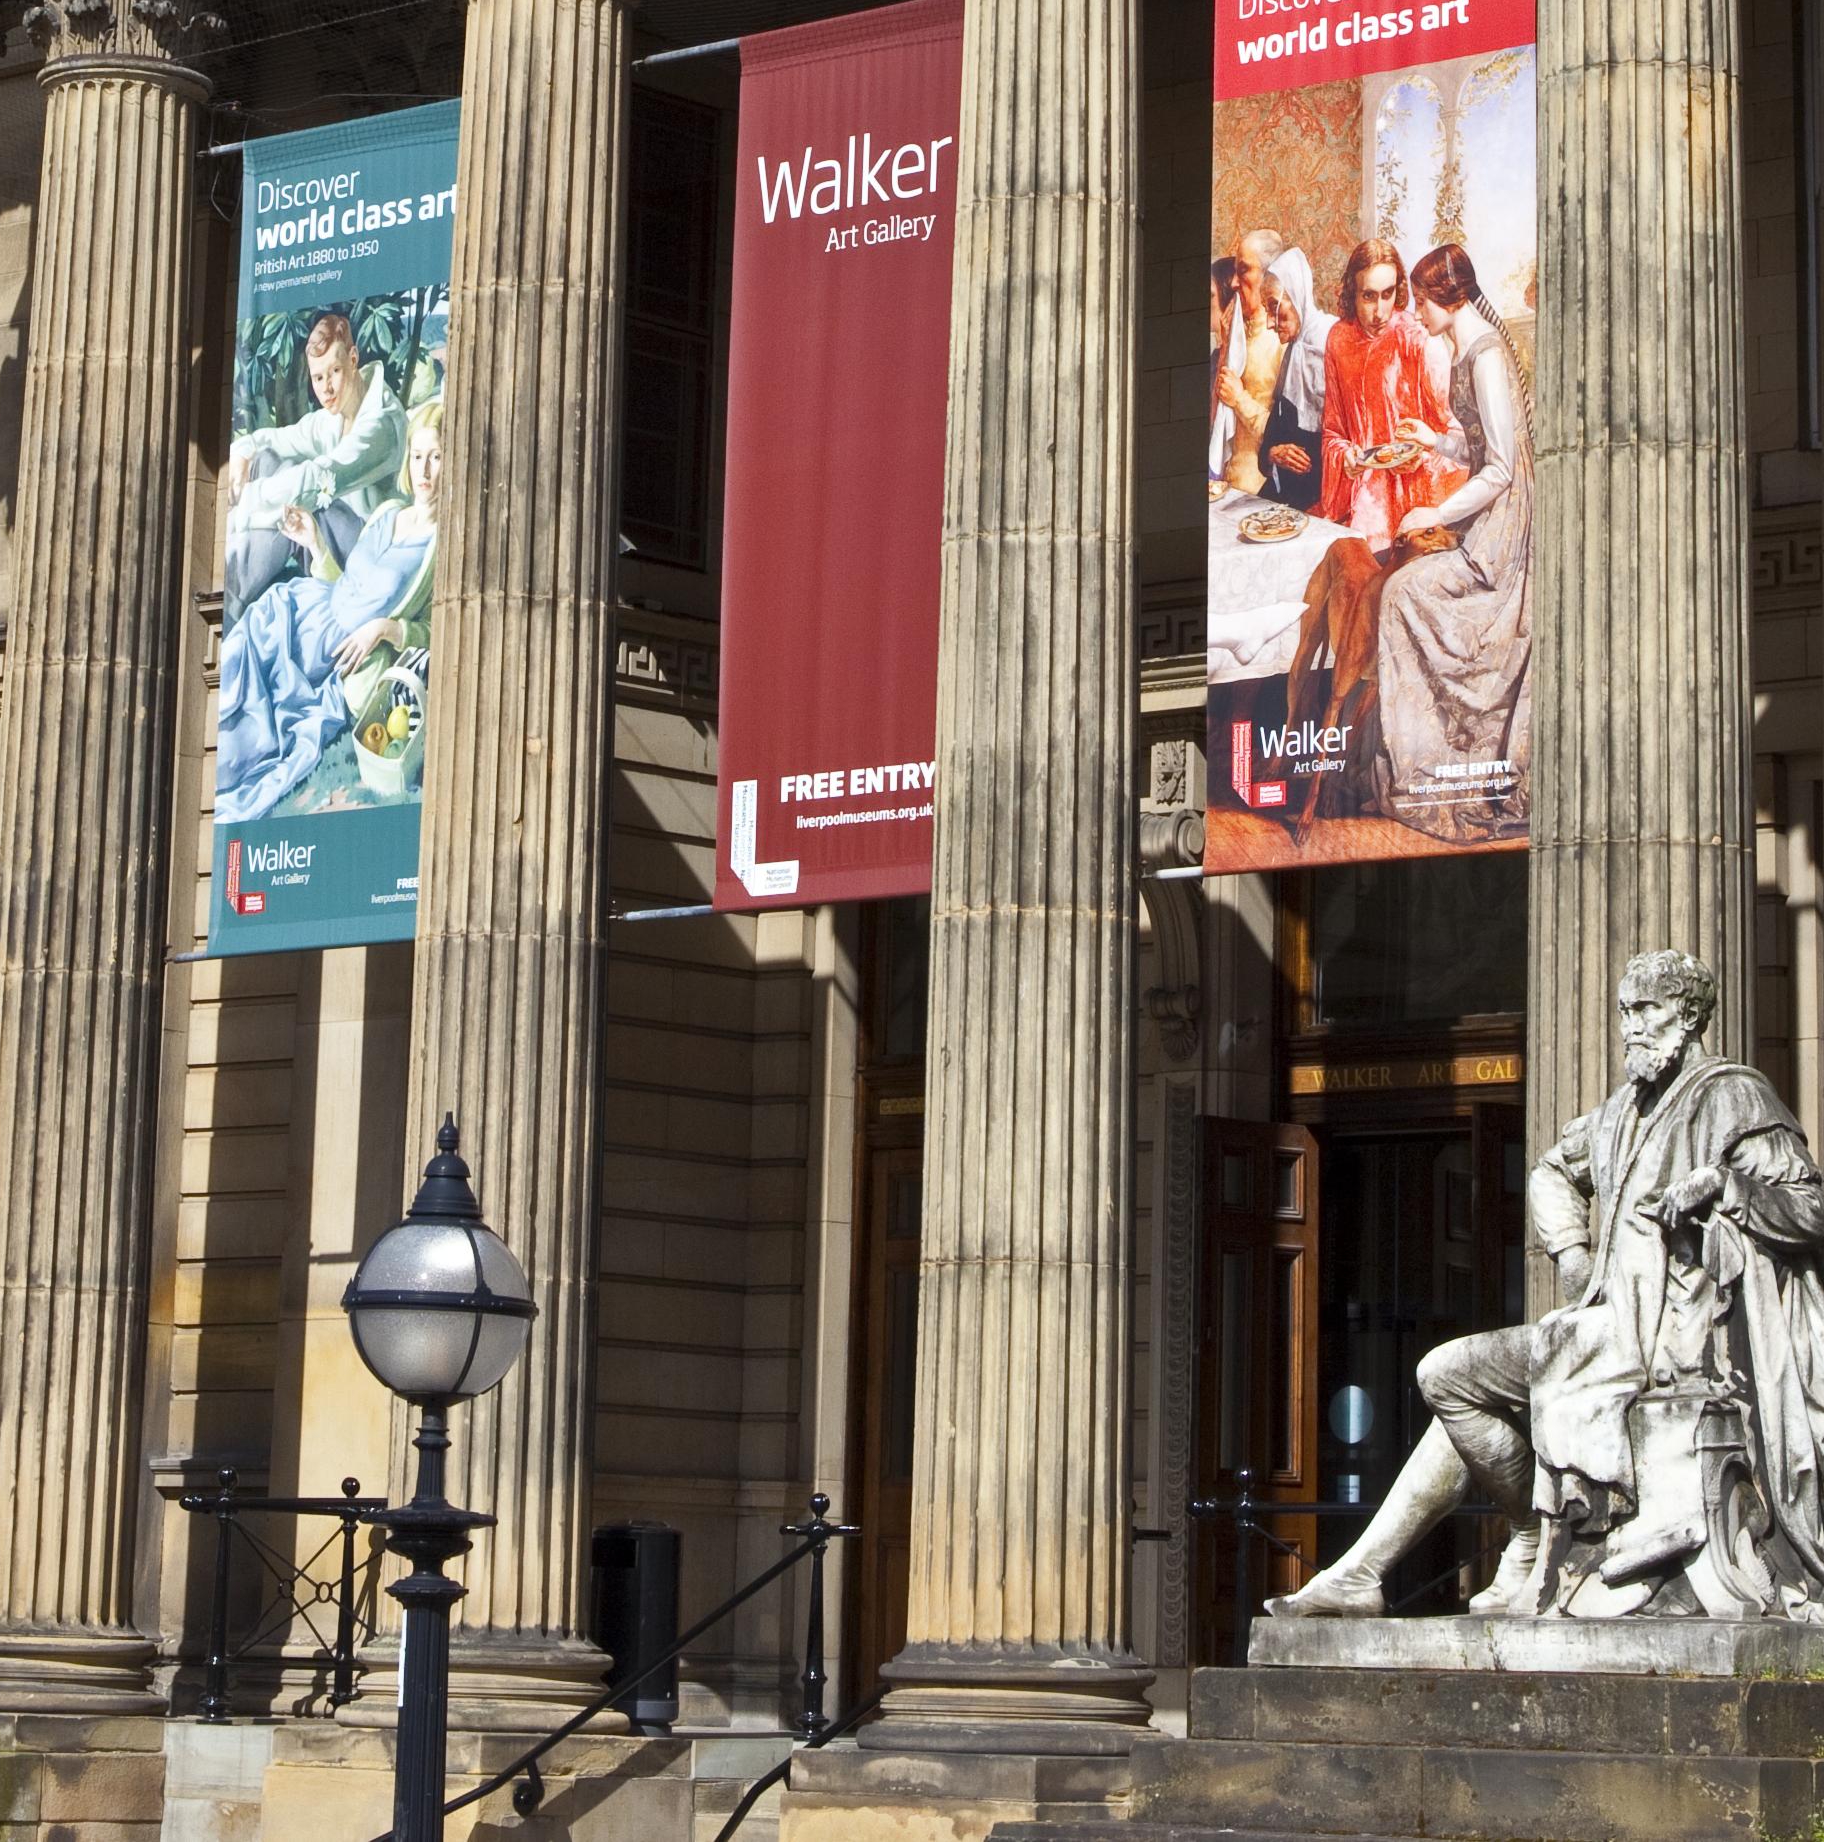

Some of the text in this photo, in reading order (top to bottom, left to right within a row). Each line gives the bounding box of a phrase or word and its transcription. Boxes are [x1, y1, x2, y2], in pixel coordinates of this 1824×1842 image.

[1237, 17, 1327, 65] world
[1335, 8, 1413, 47] class
[257, 170, 360, 213] Discover
[757, 132, 952, 224] Walker
[256, 183, 457, 250] world class art
[825, 214, 936, 252] Art Gallery
[255, 239, 379, 276] British Art 1880 to 1950
[259, 280, 275, 292] new
[275, 273, 316, 291] permanent
[317, 269, 342, 284] gallery
[1259, 720, 1353, 760] Walker
[780, 761, 936, 803] FREE ENTRY
[1293, 757, 1346, 774] Art Gallery
[1435, 760, 1512, 778] FREE ENTRY
[1408, 776, 1512, 795] liverpoolmuseums.org.uk
[796, 802, 934, 829] liverpoolmuseums.org.uk
[247, 840, 316, 873] Walker
[271, 873, 310, 886] Art Gallery
[396, 877, 419, 889] FREE
[1311, 1060, 1518, 1089] WALKER ART GAL
